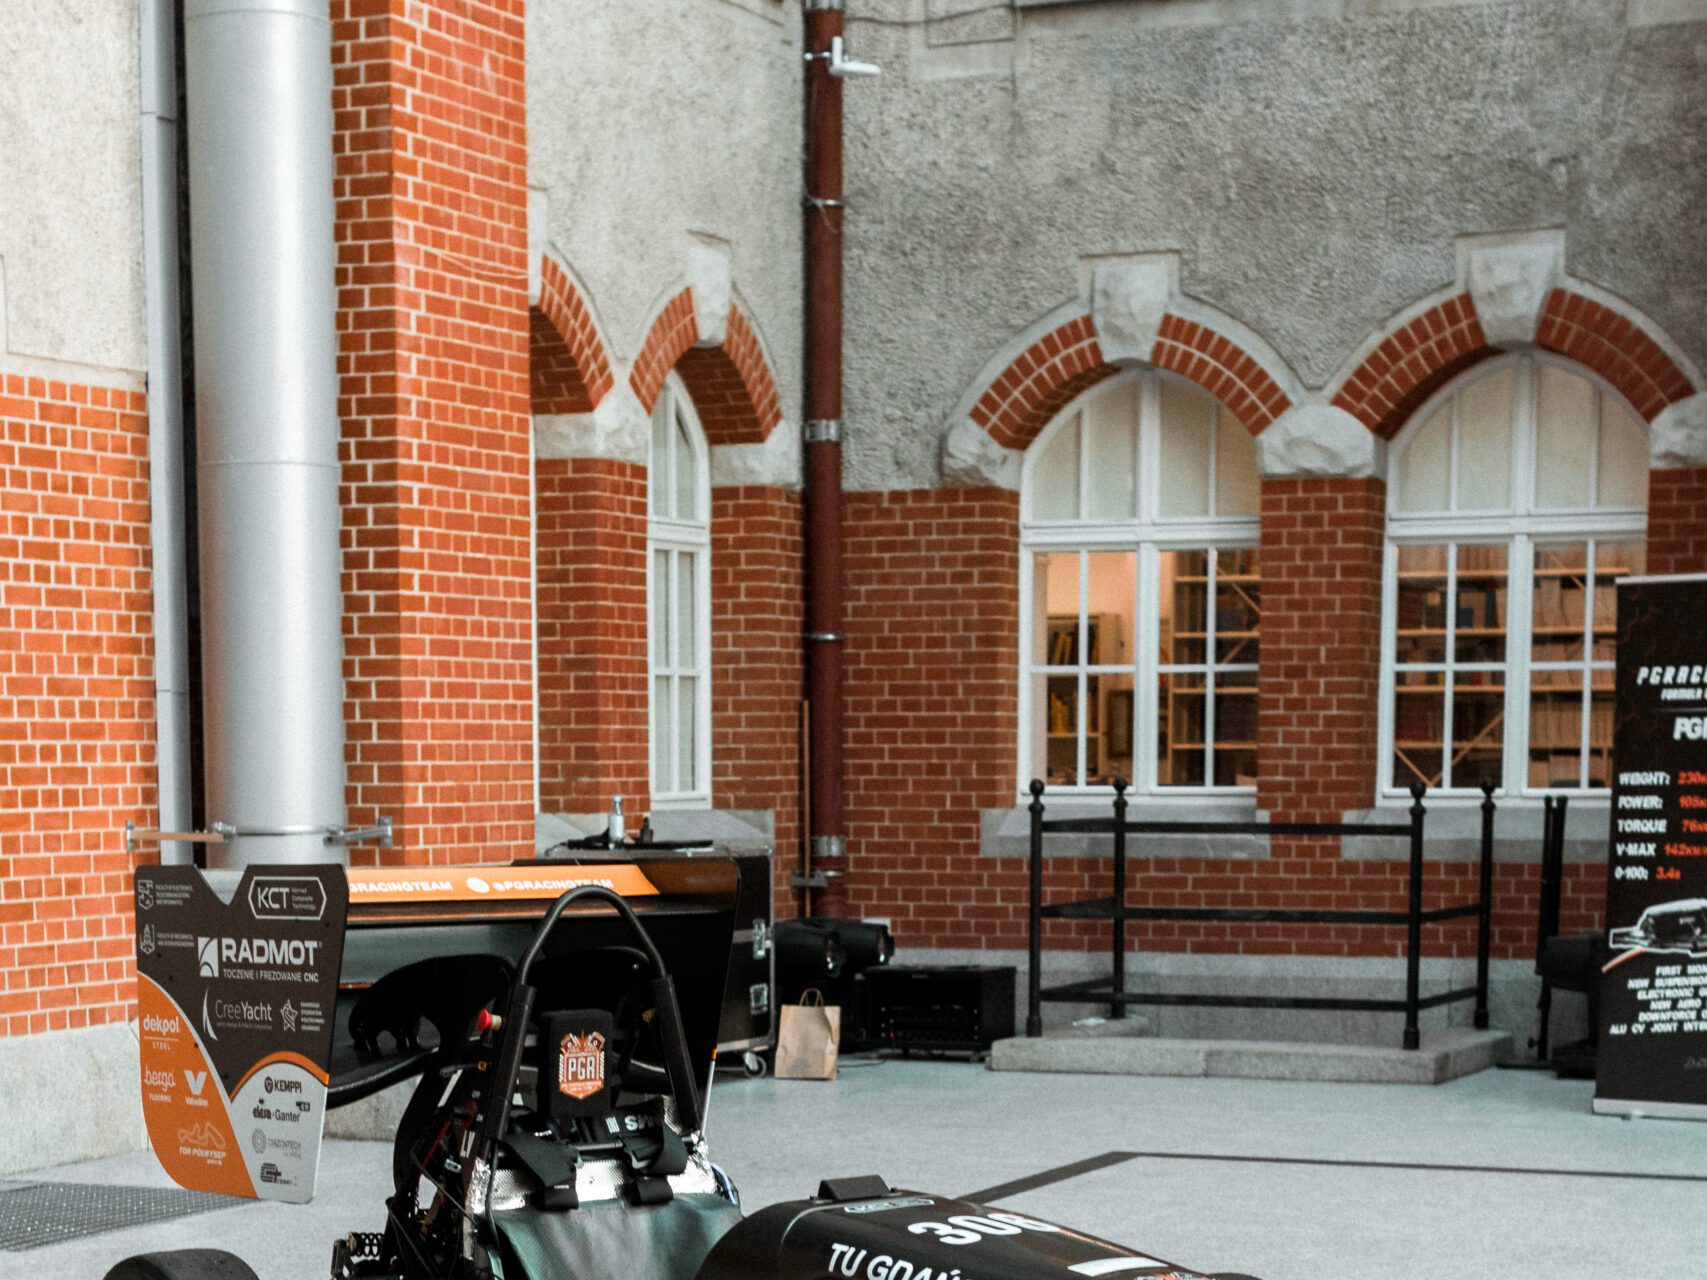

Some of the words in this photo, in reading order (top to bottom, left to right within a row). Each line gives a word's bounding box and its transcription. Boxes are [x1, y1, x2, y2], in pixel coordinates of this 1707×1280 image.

[1618, 819, 1667, 833] TORQUE
[257, 887, 290, 909] KCT
[222, 937, 318, 966] RADMOT
[223, 968, 254, 980] TOCZENIE
[260, 970, 302, 982] FREZOWANIE
[303, 972, 319, 983] CNC
[215, 999, 273, 1022] CreeYacht
[143, 1014, 180, 1036] dekpol
[144, 1064, 176, 1092] bergo
[274, 1079, 302, 1094] KEMPPI
[828, 1242, 867, 1278] TU
